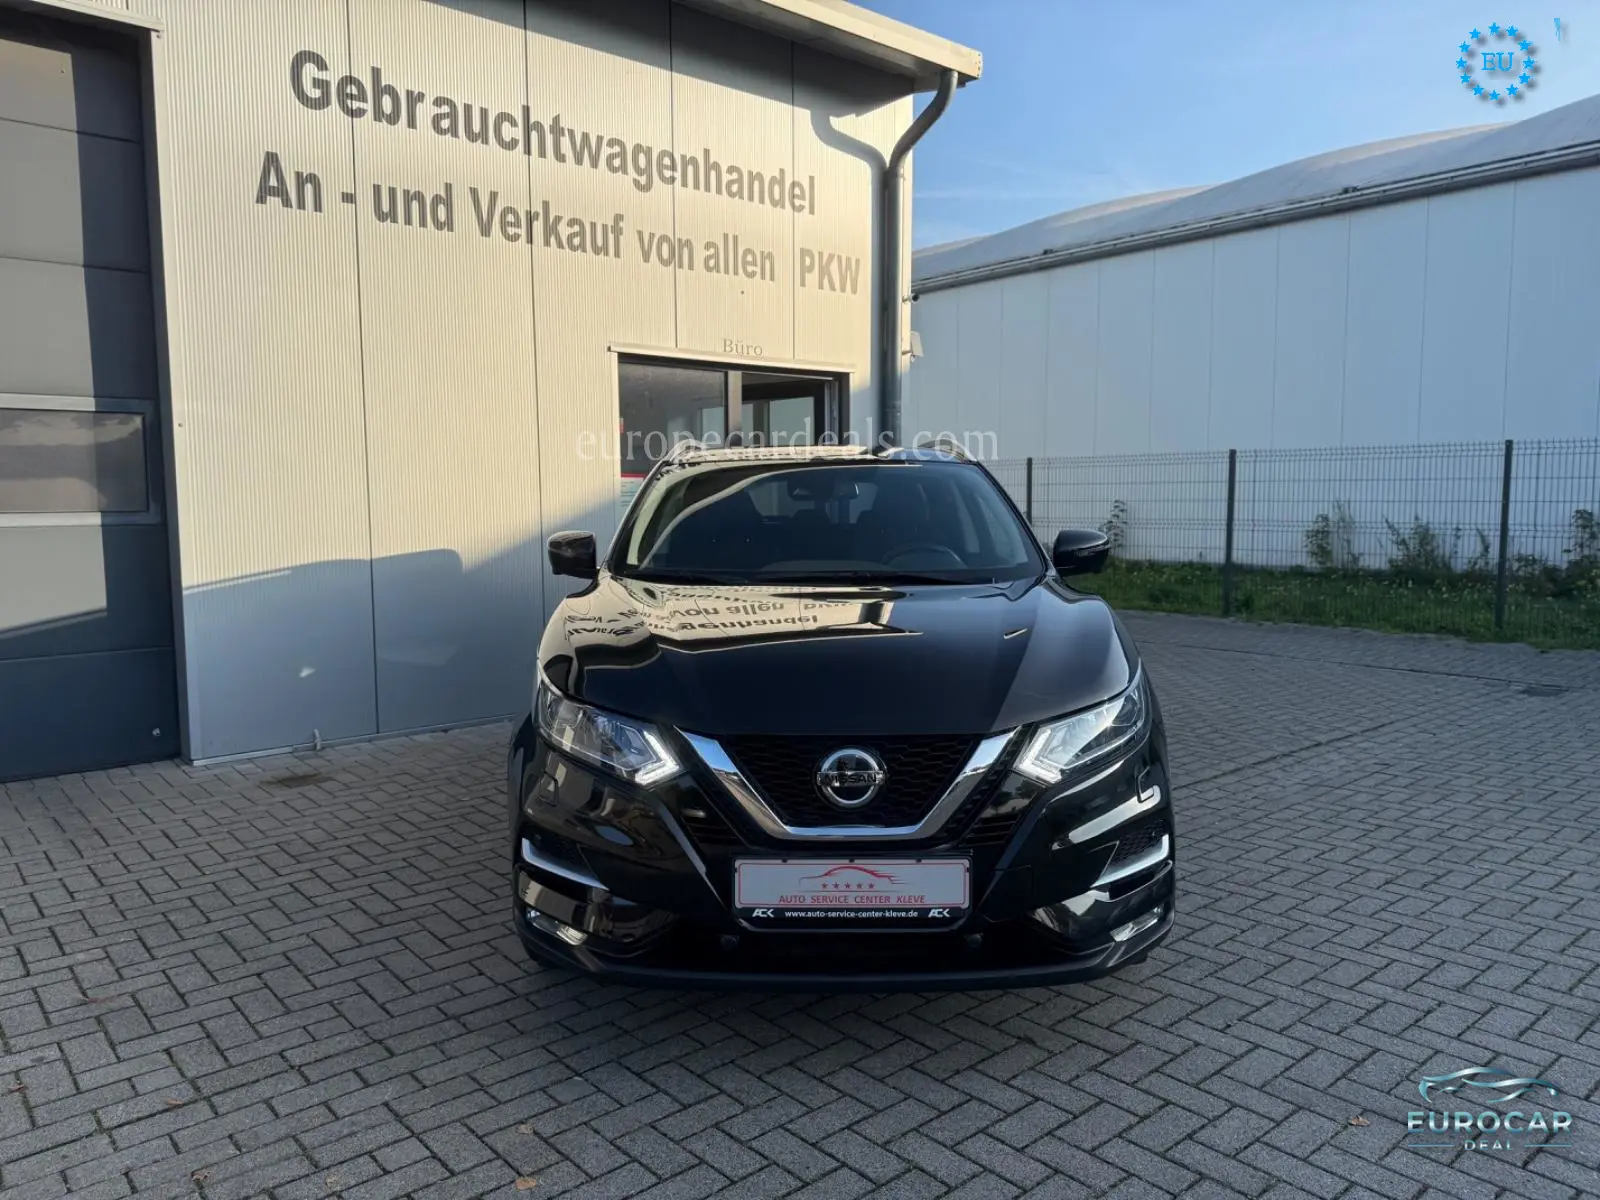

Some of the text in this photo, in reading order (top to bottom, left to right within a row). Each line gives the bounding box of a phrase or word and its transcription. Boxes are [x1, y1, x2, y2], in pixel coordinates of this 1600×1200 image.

[290, 49, 815, 216] Gebrauchtwagenhandel
[256, 150, 323, 214] An
[372, 181, 454, 232] und
[469, 186, 624, 258] Verkauf
[636, 229, 694, 271] von
[703, 233, 775, 282] allen
[800, 246, 860, 295] PKW
[722, 337, 764, 357] Büro
[822, 773, 877, 784] NISSAN
[778, 895, 805, 904] AUTO
[810, 895, 849, 904] SERVICE
[854, 895, 890, 904] CENTER
[784, 909, 918, 918] www.auto-service-center-kleve.de
